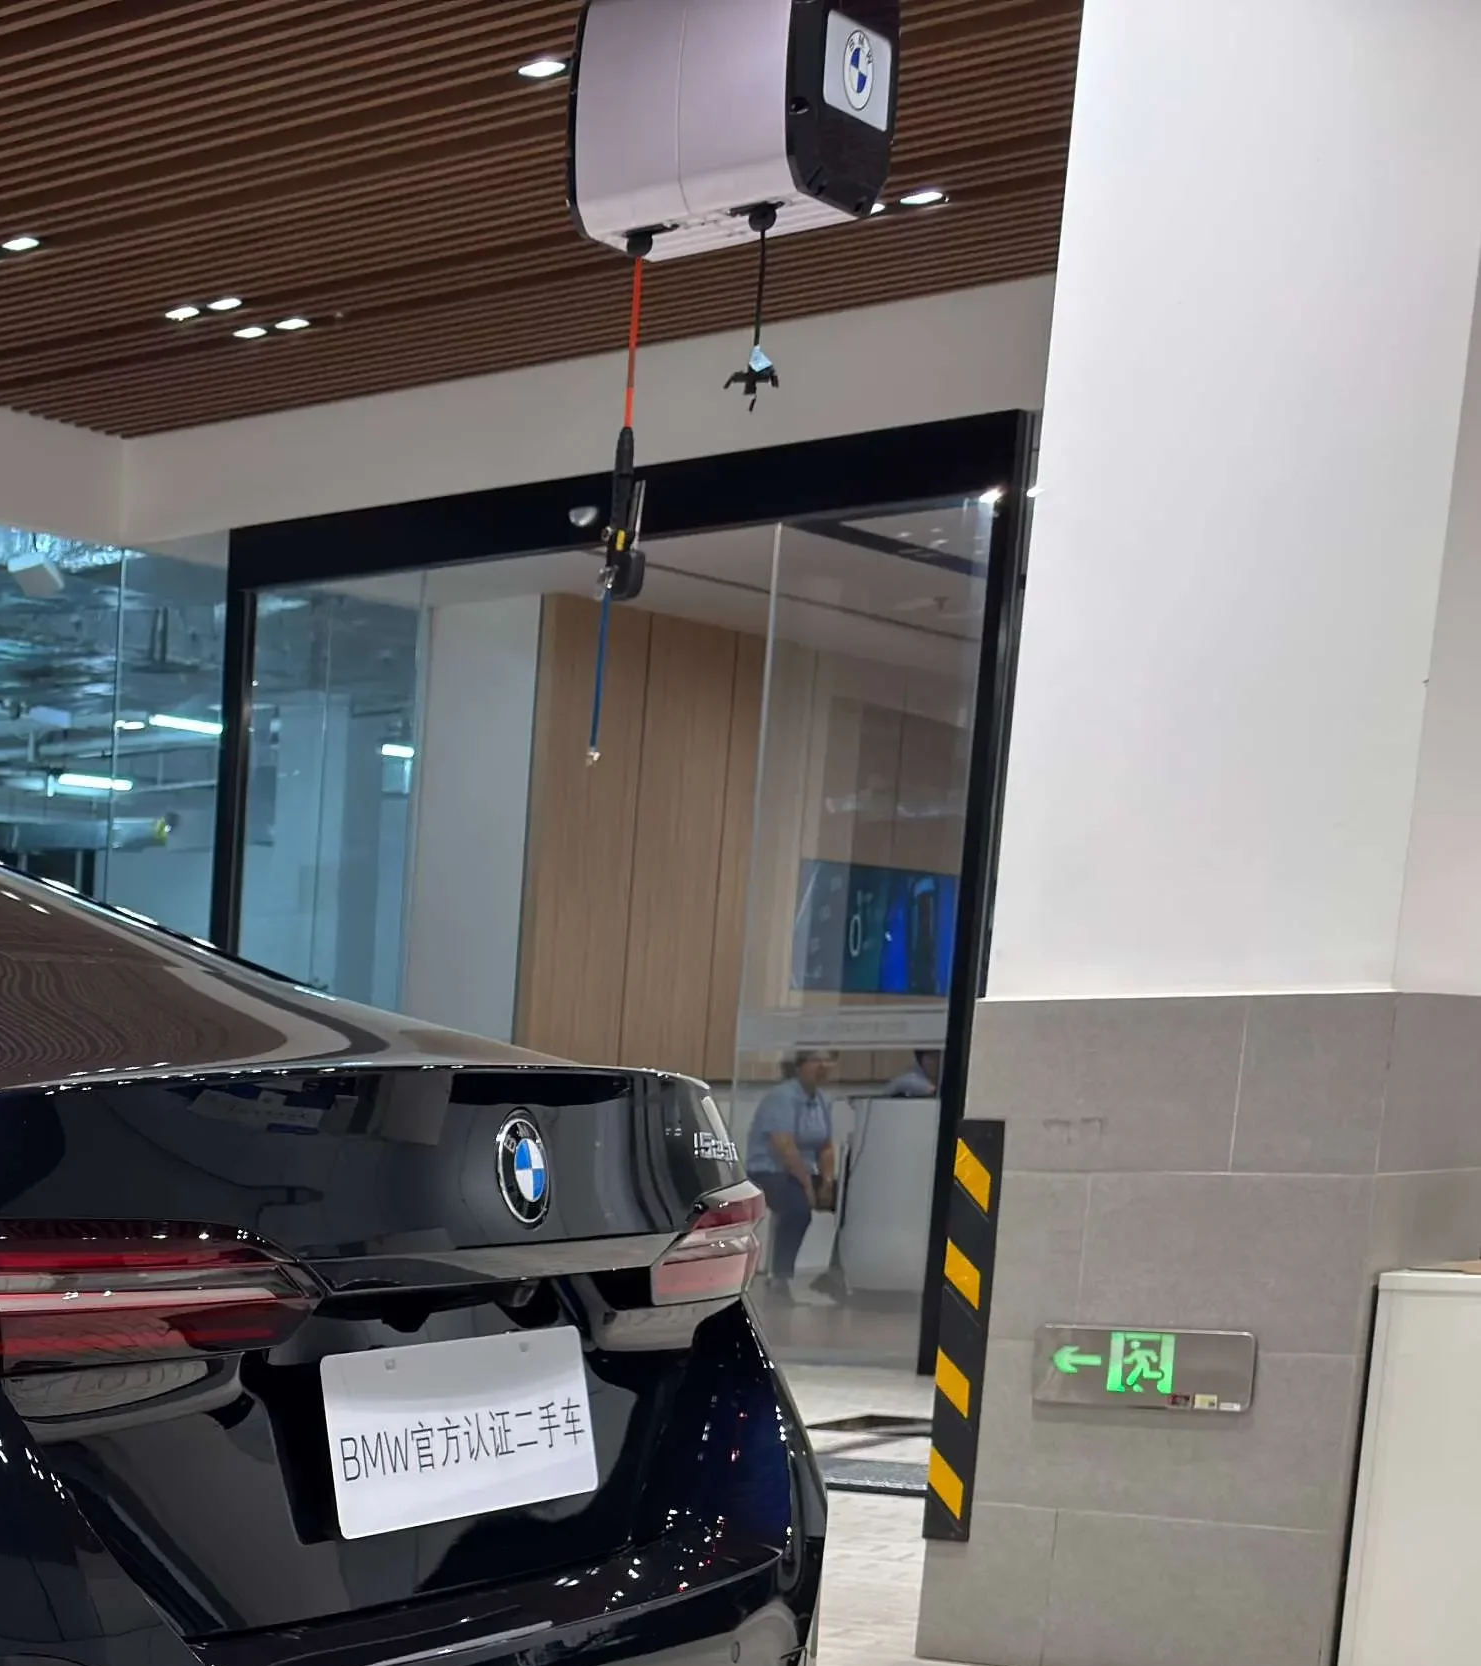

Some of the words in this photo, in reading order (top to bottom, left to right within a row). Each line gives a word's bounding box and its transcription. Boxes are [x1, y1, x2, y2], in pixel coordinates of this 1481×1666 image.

[339, 1397, 586, 1482] BMW官方认证二手车
